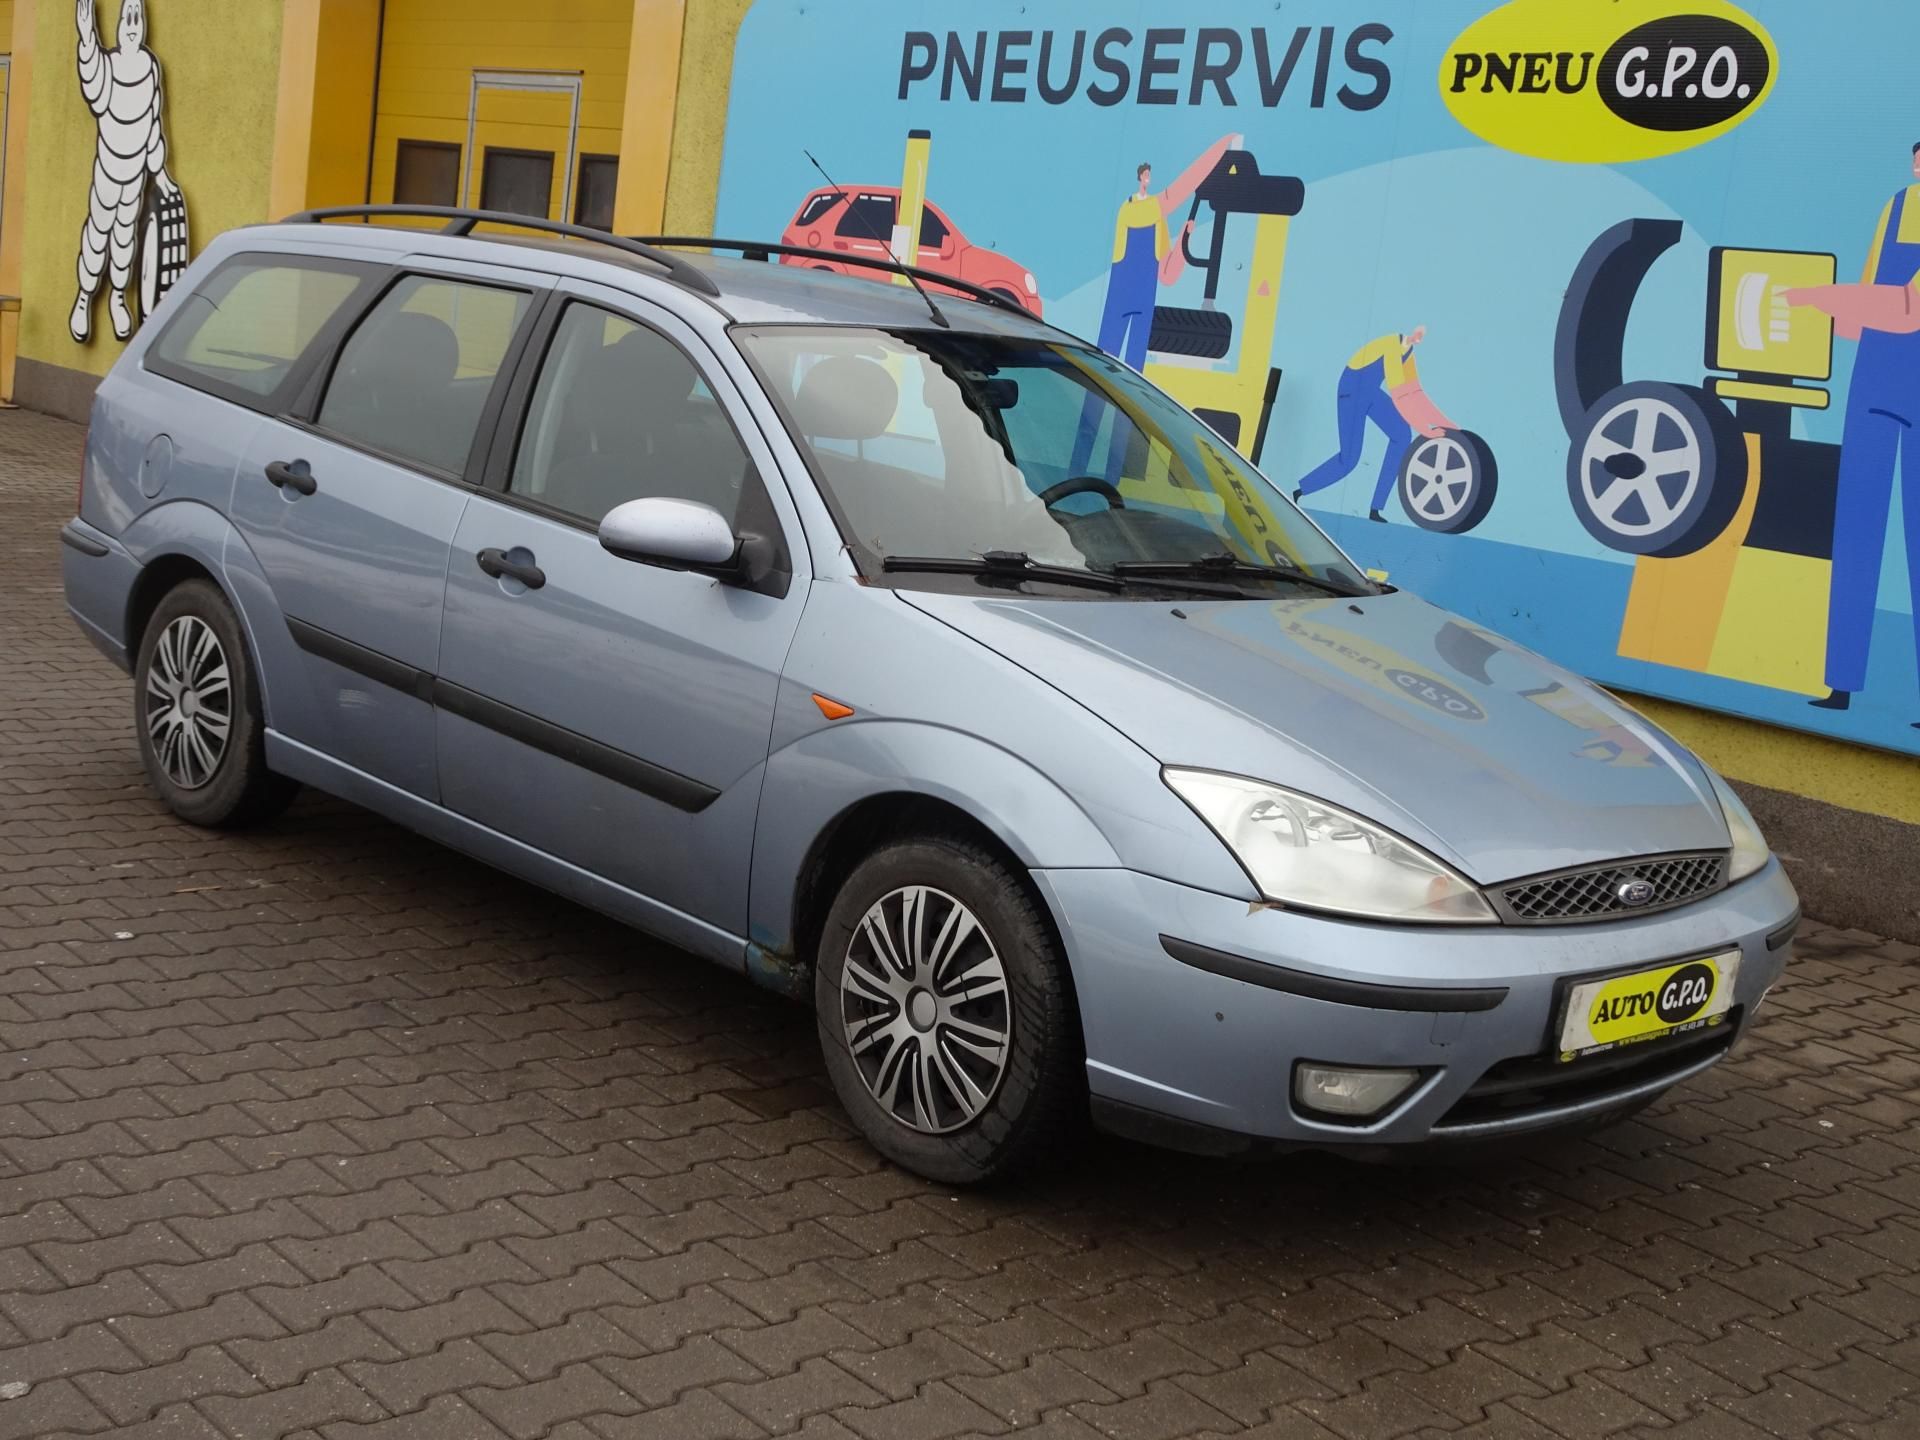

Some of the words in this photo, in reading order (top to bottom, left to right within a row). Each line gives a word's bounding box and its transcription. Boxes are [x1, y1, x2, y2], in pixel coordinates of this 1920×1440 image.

[898, 22, 1395, 112] PNEUSERVIS
[1449, 52, 1595, 94] PNEU
[1615, 45, 1751, 99] G.P.O.
[1593, 991, 1655, 1025] AUTO
[1661, 976, 1708, 1011] G.P.O.
